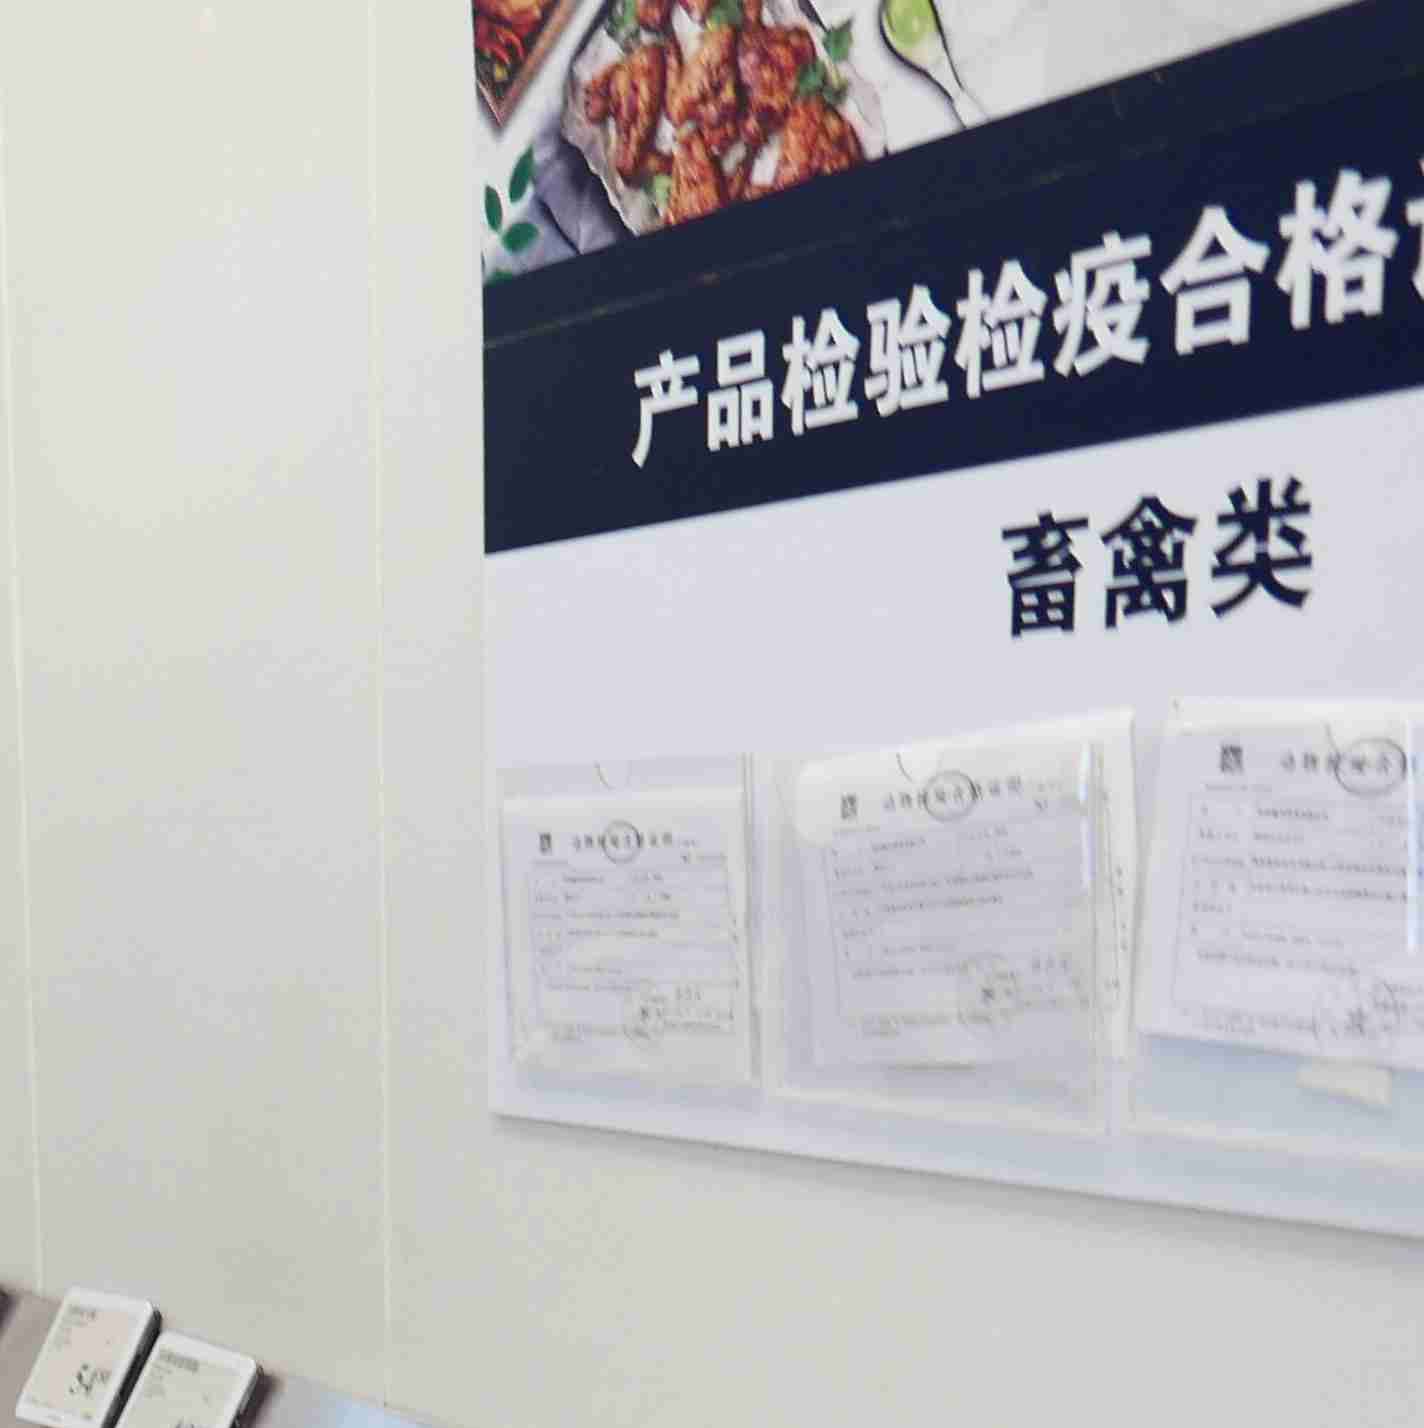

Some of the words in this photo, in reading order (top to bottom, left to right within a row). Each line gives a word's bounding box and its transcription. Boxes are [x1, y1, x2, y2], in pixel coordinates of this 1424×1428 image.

[632, 157, 1424, 467] 产品检验检疫合格
[1002, 476, 1314, 640] 畜禽类
